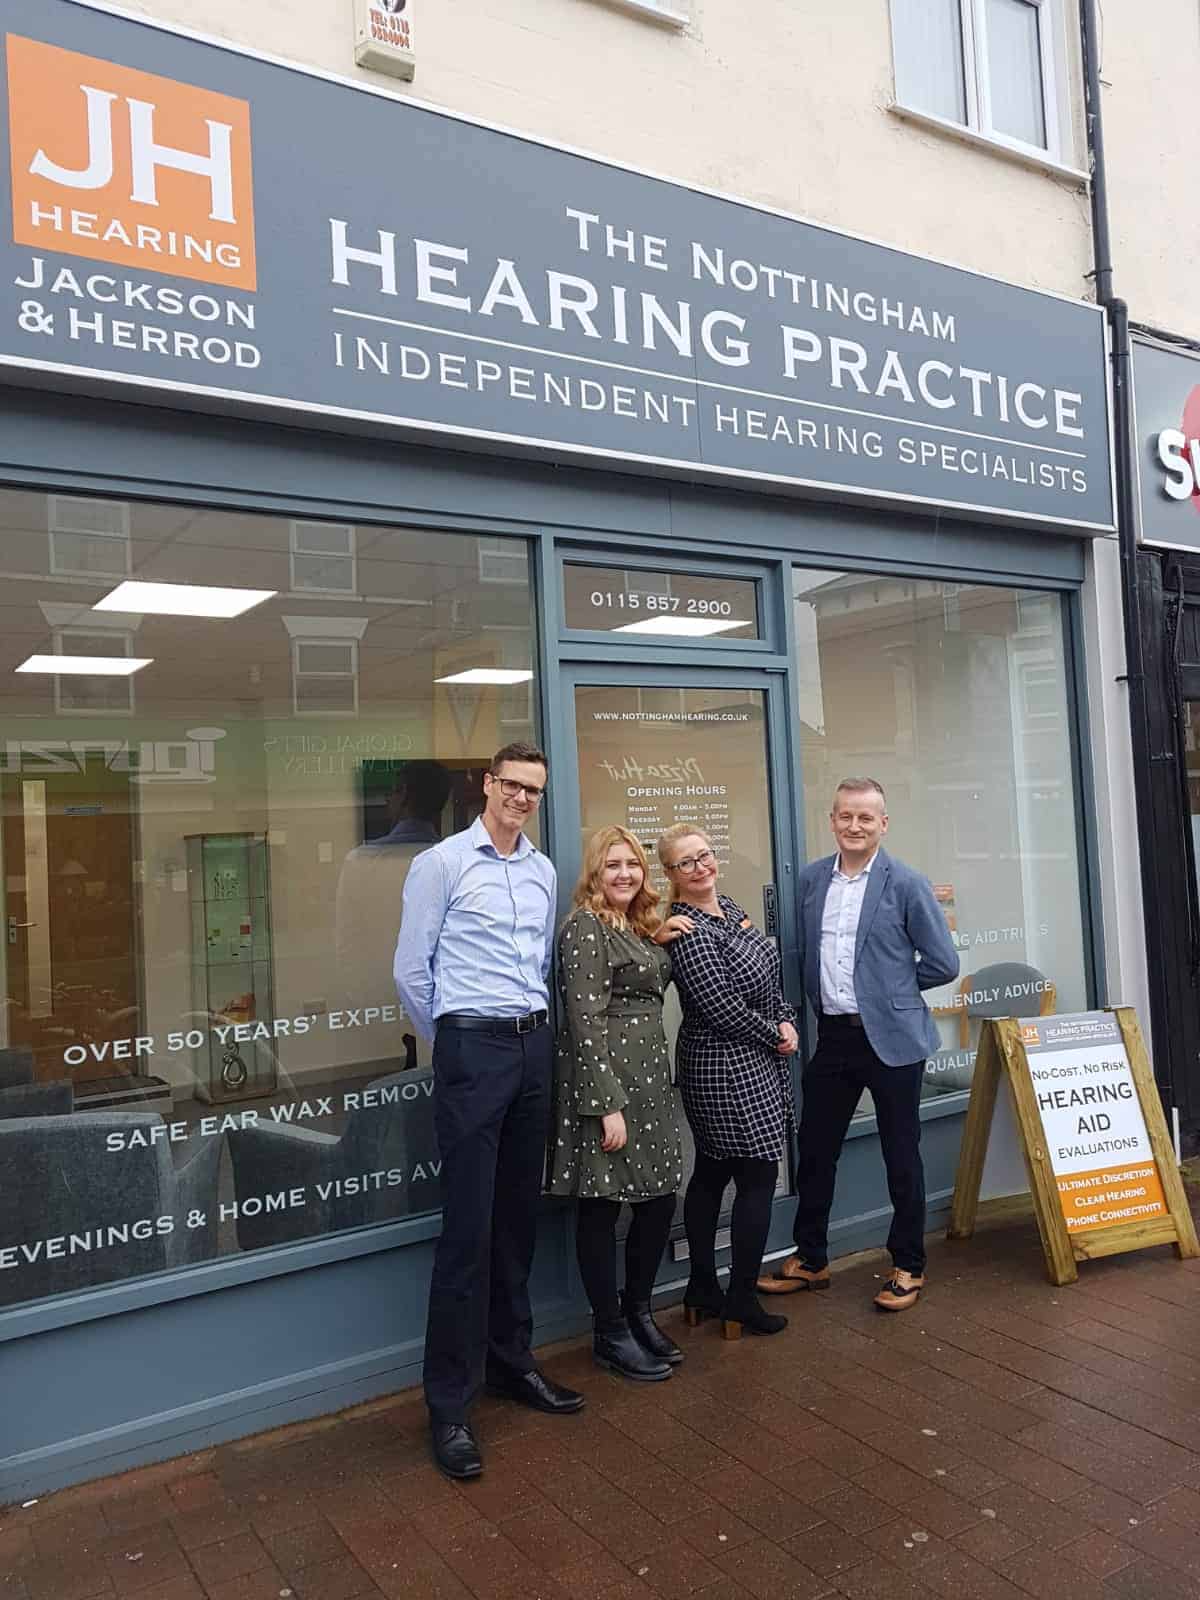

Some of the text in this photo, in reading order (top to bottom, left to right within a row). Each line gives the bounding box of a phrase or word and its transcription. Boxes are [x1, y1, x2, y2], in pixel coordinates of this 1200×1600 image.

[29, 84, 236, 224] JH
[31, 201, 241, 268] HEARING
[566, 206, 957, 343] THE NOTTINGHAM
[15, 257, 256, 329] JACKSON
[18, 300, 261, 369] & HERROD
[329, 218, 1085, 440] HEARING PRACTICE
[333, 331, 1088, 493] INDEPENDENT HEARING SPECIALISTS
[591, 592, 731, 615] 0115 857 2900
[766, 888, 776, 933] PUSH
[975, 931, 998, 945] AID
[1004, 980, 1052, 999] ADVICE
[63, 1038, 154, 1065] OVER
[167, 1030, 204, 1051] 50
[1084, 1063, 1100, 1074] NO
[1101, 1061, 1125, 1072] RISK
[1038, 1082, 1133, 1111] HEARING
[106, 1121, 188, 1153] SAFE
[200, 1110, 260, 1138] EAR
[271, 1096, 333, 1124] WAX
[1077, 1113, 1111, 1134] AID
[1058, 1137, 1139, 1159] EVALUATIONS
[1057, 1168, 1154, 1192] ULTIMATE DISCRETION
[1075, 1187, 1146, 1207] CLEAR HEARING
[0, 1214, 175, 1269] EVENINGS
[186, 1210, 207, 1229] &
[218, 1187, 306, 1223] HOME
[315, 1168, 402, 1201] VISITS
[1066, 1203, 1161, 1227] PHONE CONNECTIVITY
